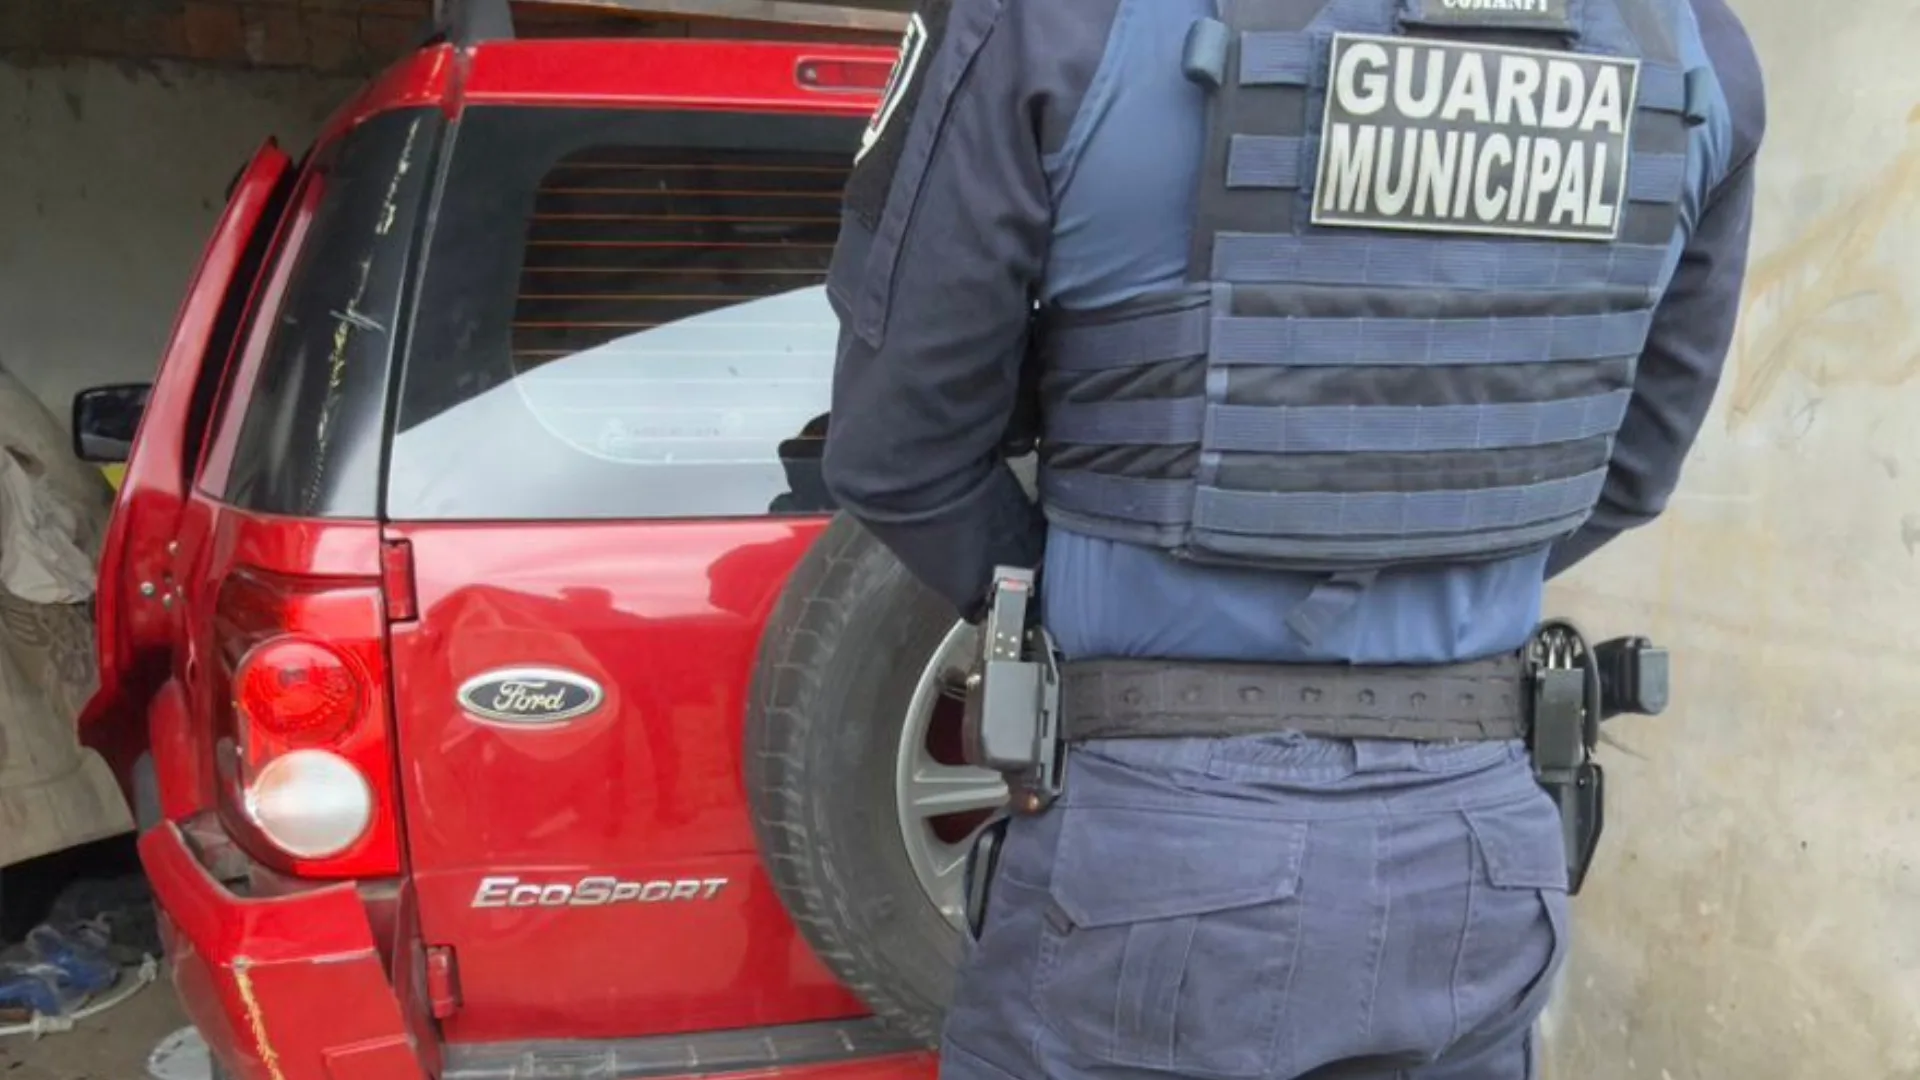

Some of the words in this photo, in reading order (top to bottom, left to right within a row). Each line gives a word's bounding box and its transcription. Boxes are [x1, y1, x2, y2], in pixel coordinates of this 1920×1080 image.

[1337, 42, 1623, 134] GUARDA
[1322, 122, 1615, 227] MUNICIPAL
[492, 680, 566, 712] Ford
